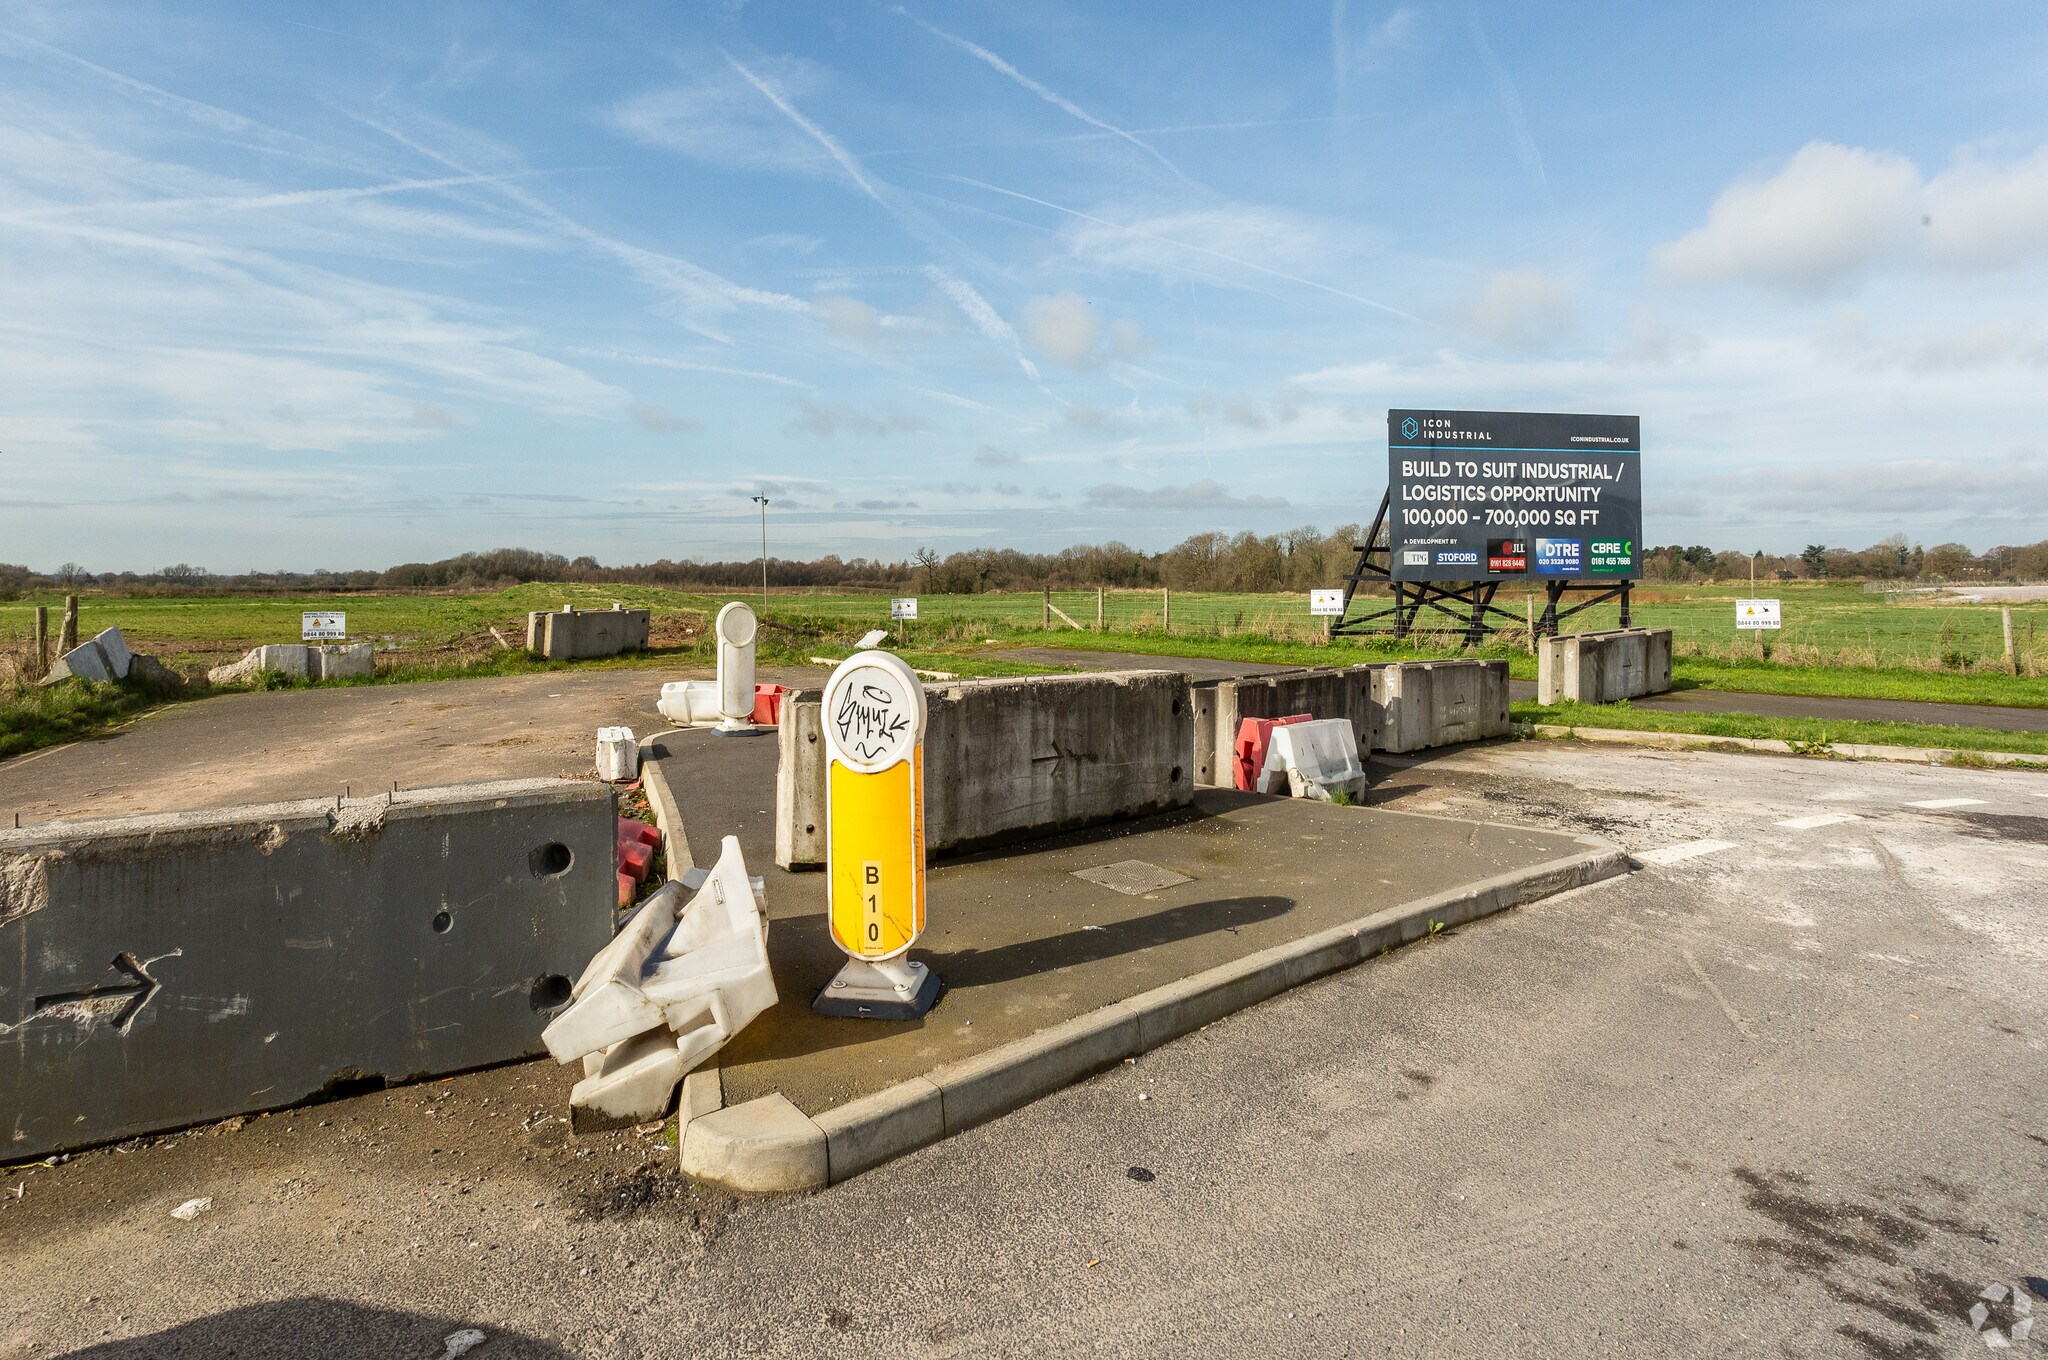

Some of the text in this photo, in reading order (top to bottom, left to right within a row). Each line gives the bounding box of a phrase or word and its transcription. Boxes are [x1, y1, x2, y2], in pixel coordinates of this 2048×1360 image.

[1423, 419, 1451, 428] ICON
[1423, 430, 1492, 440] INDUSTRIAL
[1570, 436, 1630, 444] ICONINDUSTRIAL.CO.UK
[1402, 460, 1625, 483] BUILD TO SUIT INDUSTRIAL /
[1402, 484, 1602, 503] LOGISTICS OPPORTUNITY
[1402, 508, 1468, 527] 100,000
[1485, 509, 1550, 528] 700,000
[1554, 510, 1577, 526] SQ
[1580, 510, 1600, 526] FT
[1512, 543, 1526, 553] JLL
[1545, 543, 1580, 557] DTRE
[1591, 542, 1621, 554] CBRE
[1437, 553, 1477, 562] STOFORD
[1591, 557, 1605, 566] 0161
[1605, 557, 1617, 566] 455
